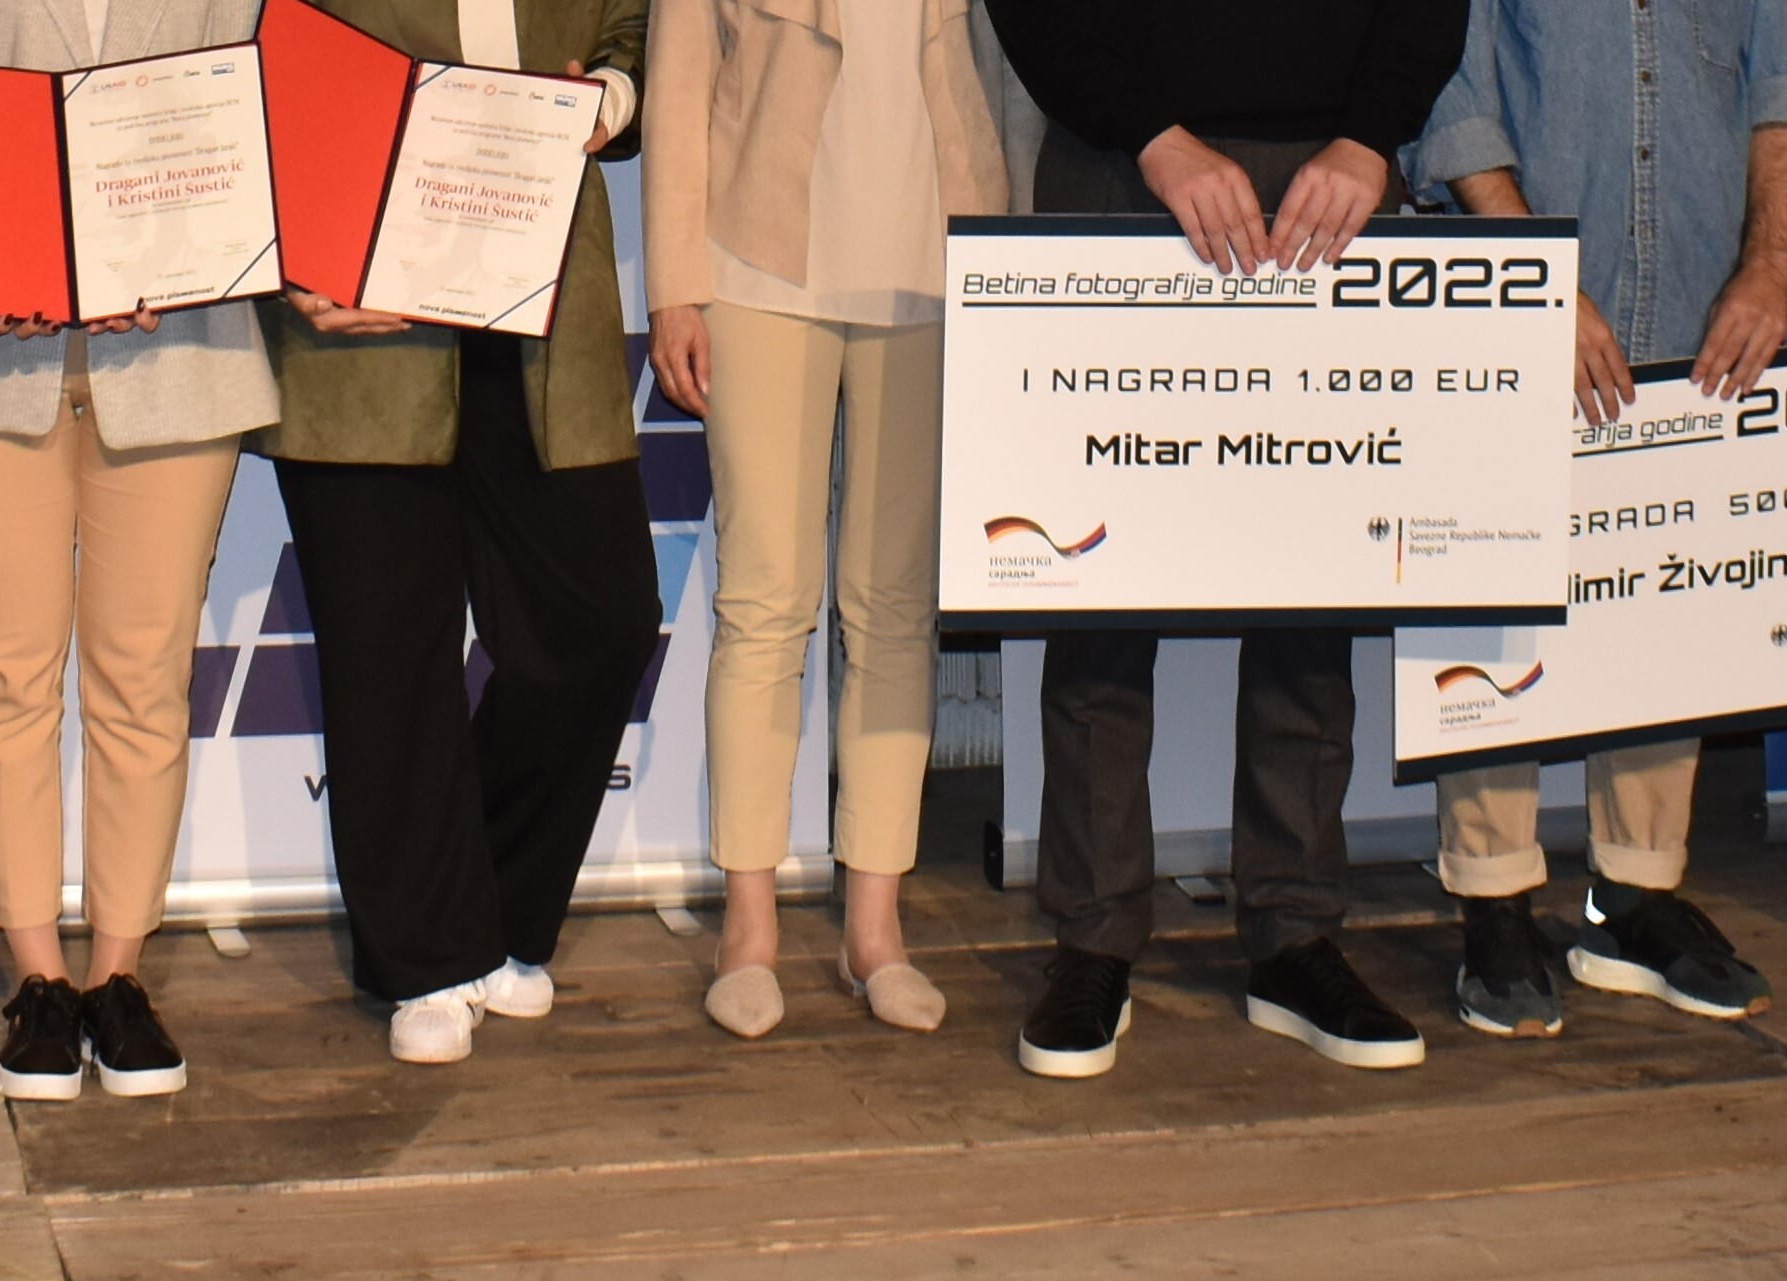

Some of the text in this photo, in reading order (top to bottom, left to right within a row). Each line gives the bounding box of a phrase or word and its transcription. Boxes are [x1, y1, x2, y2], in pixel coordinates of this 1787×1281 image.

[94, 159, 246, 194] Dragani Jovanović
[414, 176, 554, 209] Dragani Jovanović
[962, 257, 1566, 309] Betina fotografija godine 2022.
[1052, 367, 1273, 394] NAGRADA
[1296, 367, 1414, 394] 1.000
[1436, 367, 1522, 394] EUR
[1085, 426, 1402, 466] Mitar Mitrović
[1640, 411, 1724, 446] godine
[1569, 499, 1694, 538] GRADA
